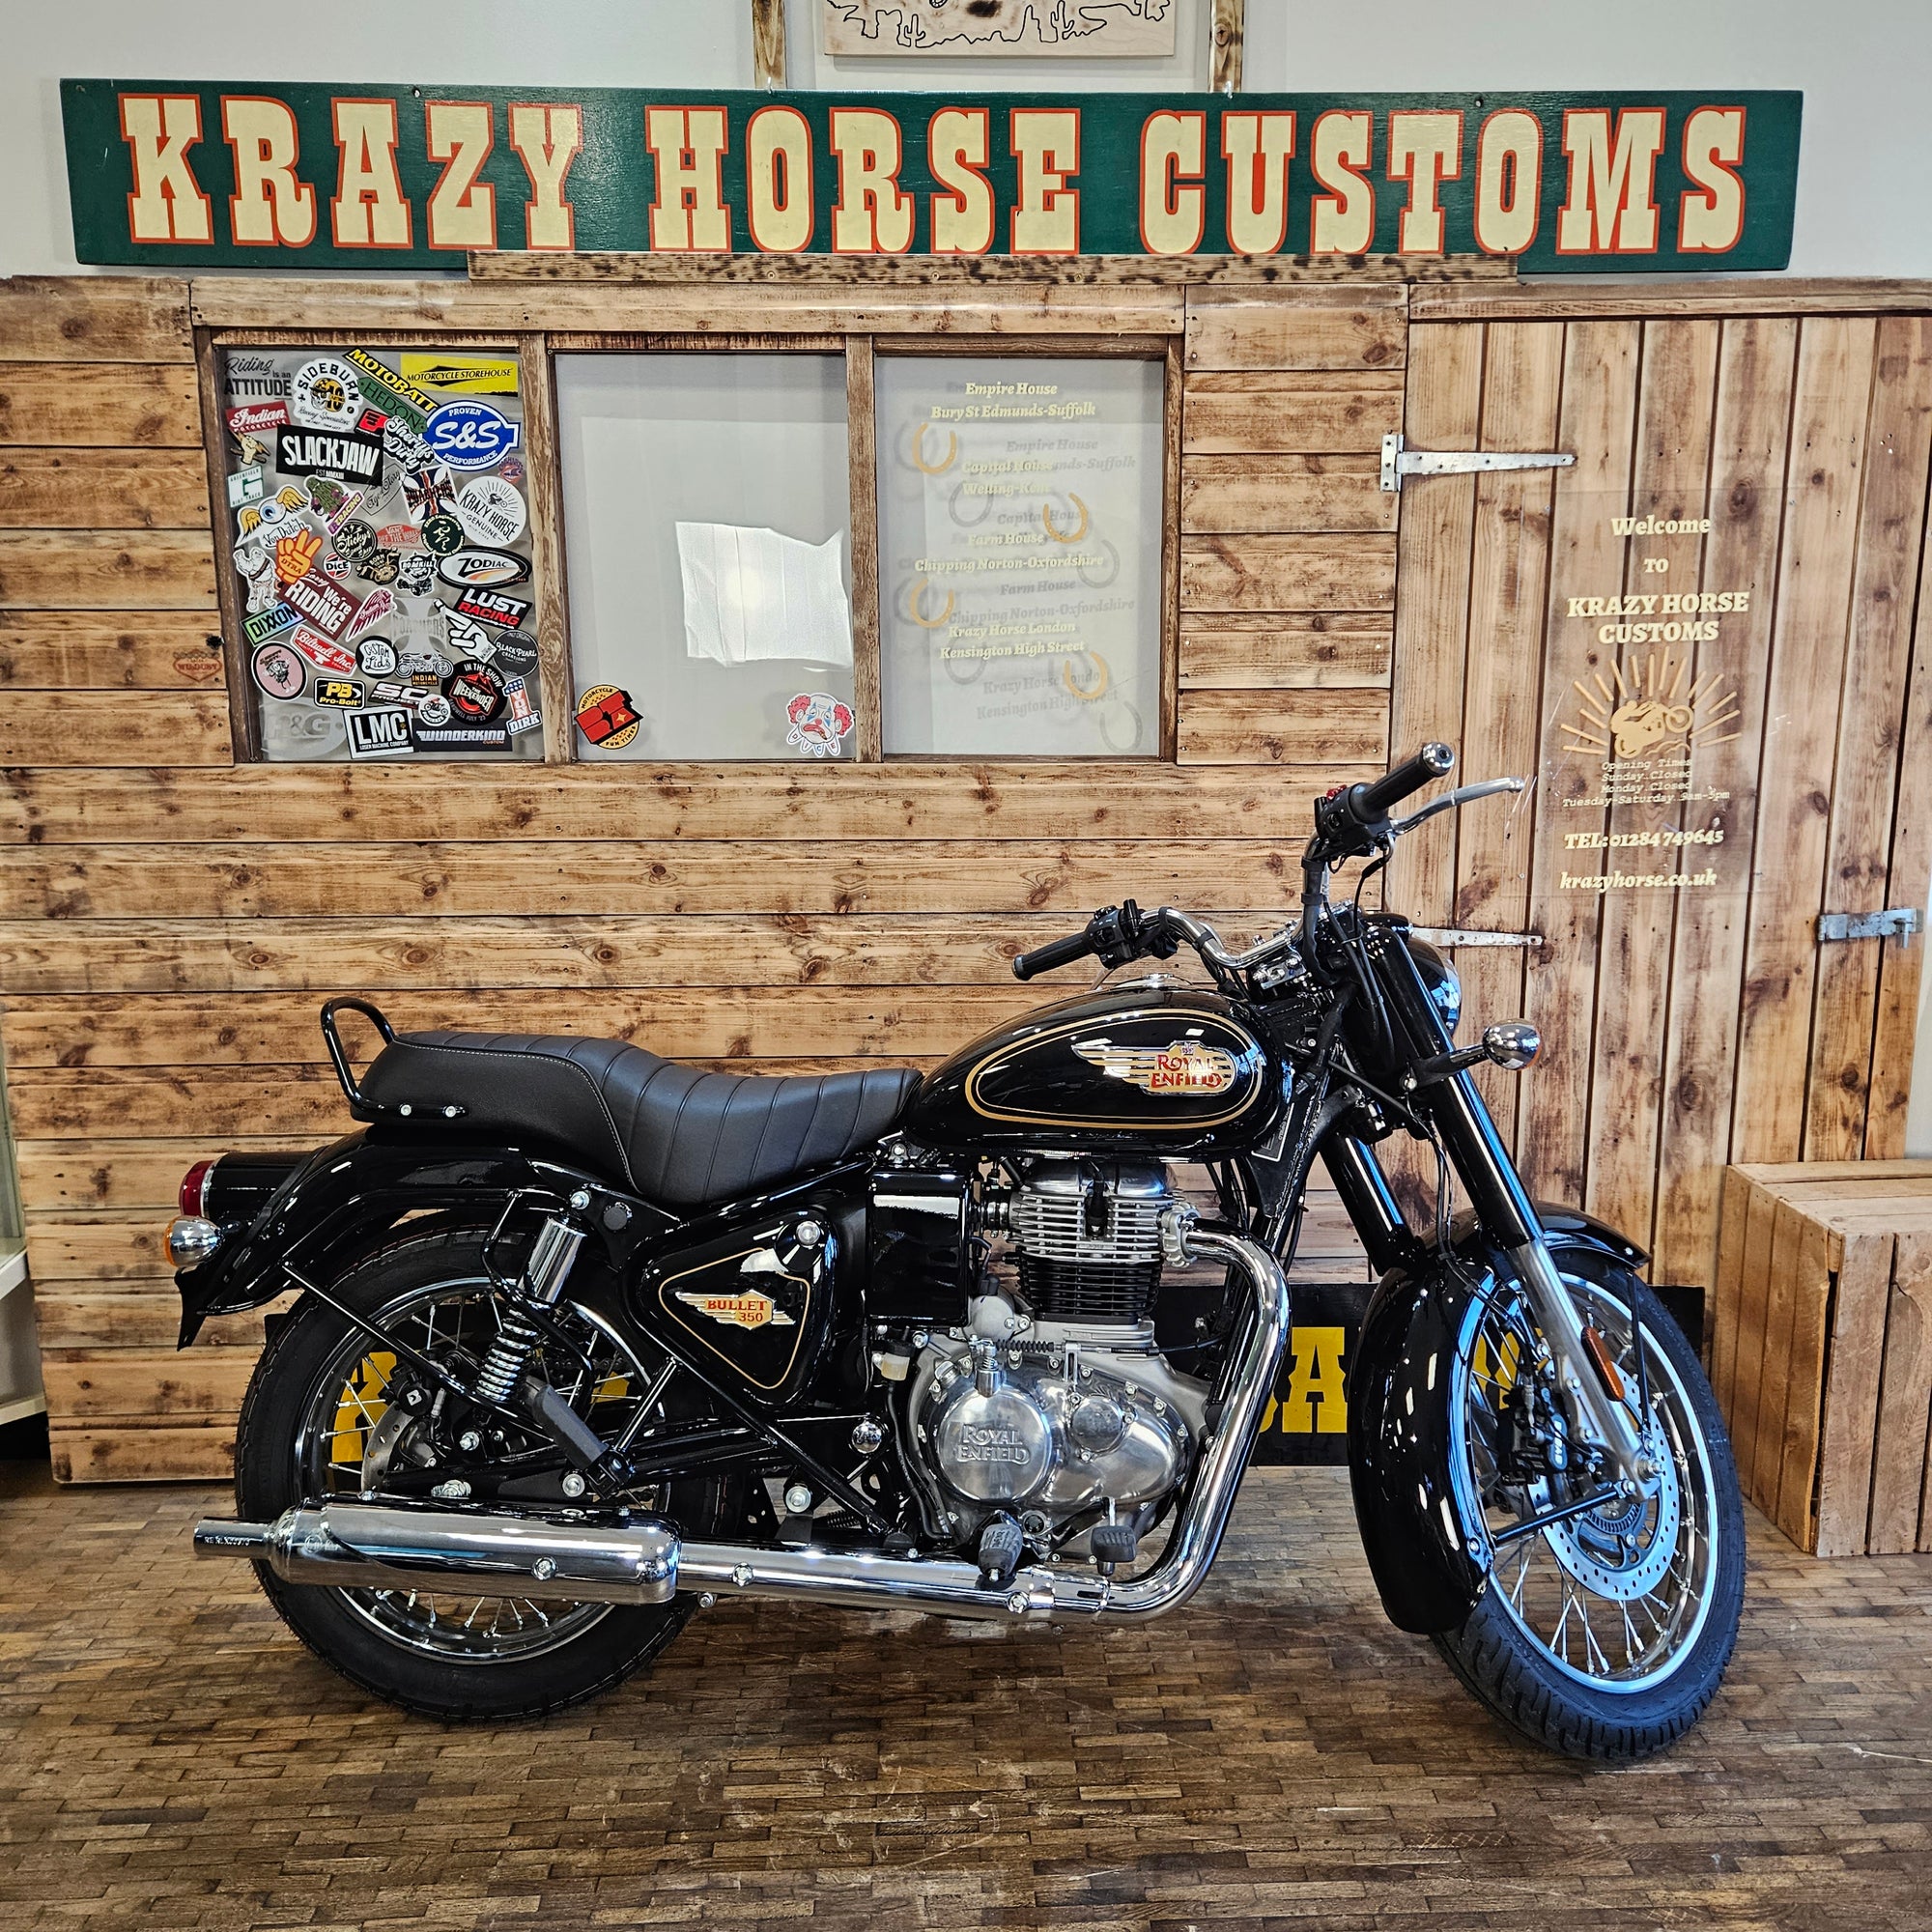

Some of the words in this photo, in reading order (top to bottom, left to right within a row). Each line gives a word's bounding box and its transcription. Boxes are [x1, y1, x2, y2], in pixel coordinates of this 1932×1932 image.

[118, 93, 582, 250] KRAZY
[644, 104, 1081, 254] HORSE
[1140, 106, 1746, 255] CUSTOMS
[224, 356, 275, 376] Riding
[407, 371, 460, 382] MOTORCYCLE
[461, 368, 512, 379] STOREHOUSE
[224, 378, 292, 396] ATTITUDE
[298, 363, 359, 401] SIDEBURN
[349, 349, 439, 412] MOTOBATT
[965, 381, 1015, 398] Empire
[1016, 383, 1058, 395] House
[363, 383, 421, 429] HEDON
[448, 407, 482, 417] PROVEN
[930, 405, 965, 421] Bury
[965, 405, 980, 418] St
[980, 402, 1096, 420] Edmunds-Suffolk
[229, 408, 286, 428] Indian
[432, 421, 501, 450] S&S
[281, 435, 380, 476] SLACKJAW
[442, 449, 498, 466] PERFORMANCE
[460, 489, 492, 519] KRAZY
[488, 511, 520, 542] HORSE
[1610, 514, 1712, 536] Welcome
[276, 518, 306, 537] Dutch
[466, 514, 498, 540] GENUINE
[968, 534, 1003, 547] Farm
[1004, 533, 1045, 546] House
[280, 557, 303, 574] DTRA
[457, 557, 509, 578] ZODIAC
[914, 559, 976, 575] Chipping
[977, 554, 1104, 571] Norton-Oxfordshire
[1643, 557, 1669, 574] TO
[284, 580, 346, 634] RIDING
[322, 585, 353, 615] We're
[463, 587, 526, 615] LUST
[1567, 594, 1659, 617] KRAZY
[1661, 591, 1750, 614] HORSE
[248, 606, 298, 639] DIXXON
[458, 601, 521, 626] RACING
[948, 626, 988, 639] Krazy
[988, 624, 1028, 636] Horse
[1028, 621, 1076, 635] London
[1599, 620, 1719, 644] CUSTOMS
[297, 631, 338, 658] Biltwell
[939, 644, 1012, 661] Kensington
[1013, 641, 1045, 658] High
[1046, 640, 1085, 653] Street
[464, 664, 471, 672] IN
[471, 663, 485, 673] THE
[485, 668, 503, 688] SHOW
[326, 682, 353, 698] PB
[373, 683, 428, 701] SC
[453, 679, 495, 713] WEEKENDER
[582, 687, 613, 709] MOTORCYCLE
[319, 696, 358, 706] Pro-Bolt
[354, 713, 407, 745] LMC
[509, 713, 540, 733] DIRK
[415, 730, 506, 741] WUNDERKIND
[1601, 759, 1652, 773] Opening
[1657, 758, 1692, 768] Times
[1662, 828, 1724, 847] 749645
[1559, 867, 1718, 893] krazyhorse.co.uk
[1156, 1054, 1214, 1071] ROYAL
[1151, 1072, 1223, 1089] ENFIELD
[707, 1299, 767, 1311] BULLET
[739, 1312, 763, 1321] 350
[962, 1423, 1023, 1446] ROYAL
[955, 1446, 1031, 1465] ENFIELD
